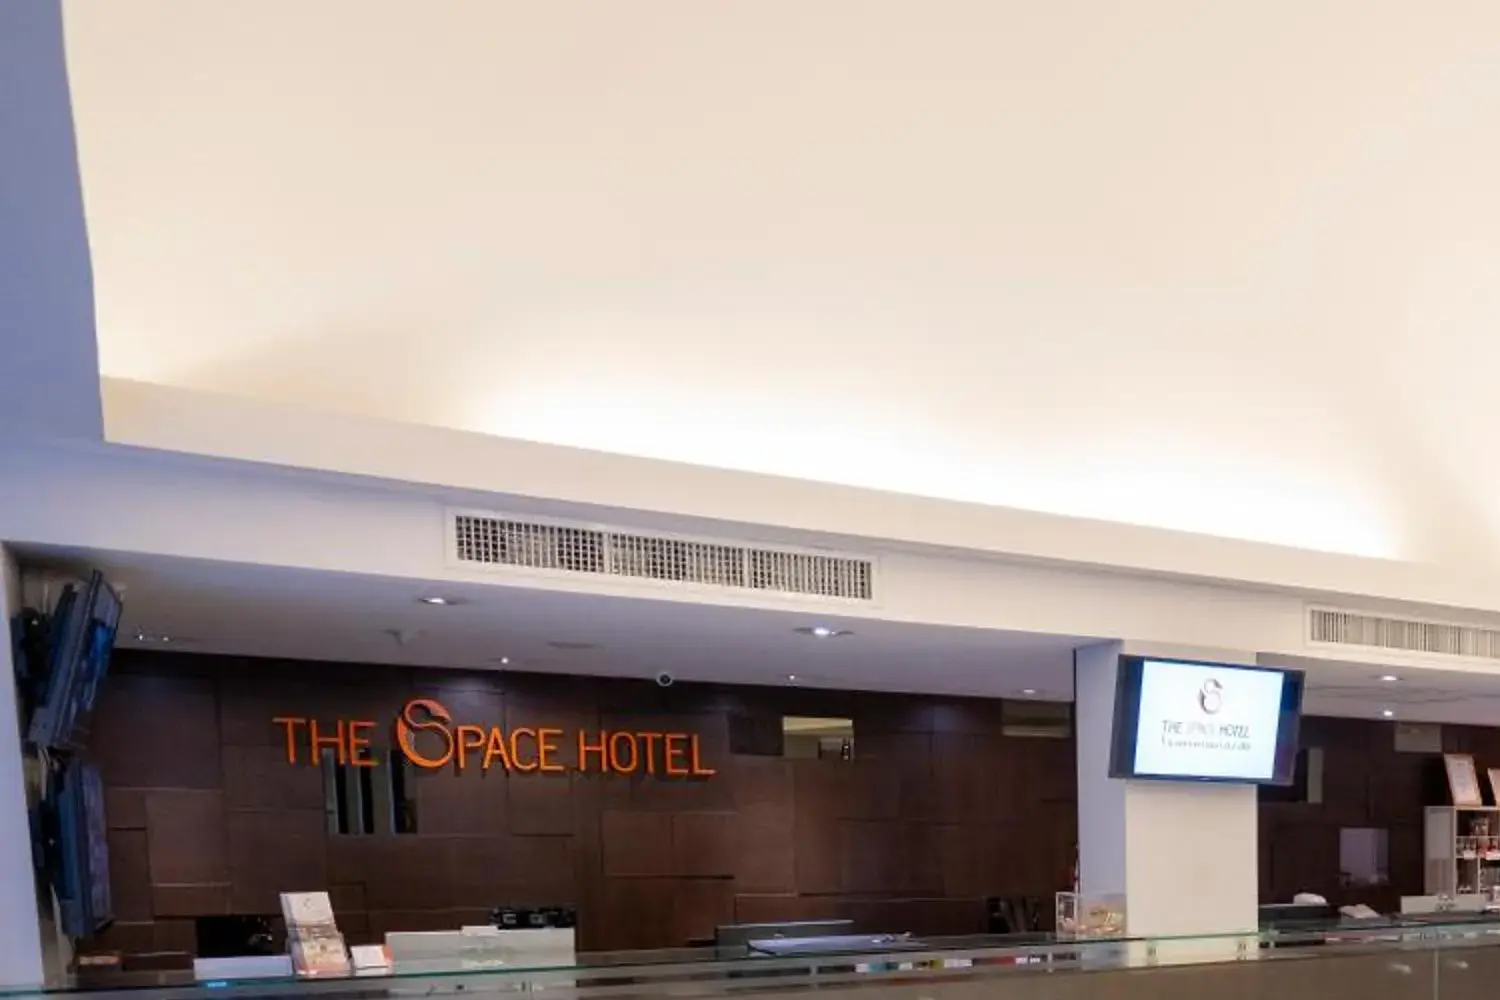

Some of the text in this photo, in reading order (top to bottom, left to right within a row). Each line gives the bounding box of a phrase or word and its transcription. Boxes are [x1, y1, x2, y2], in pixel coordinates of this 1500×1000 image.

[271, 698, 717, 776] THE SPACE HOTEL
